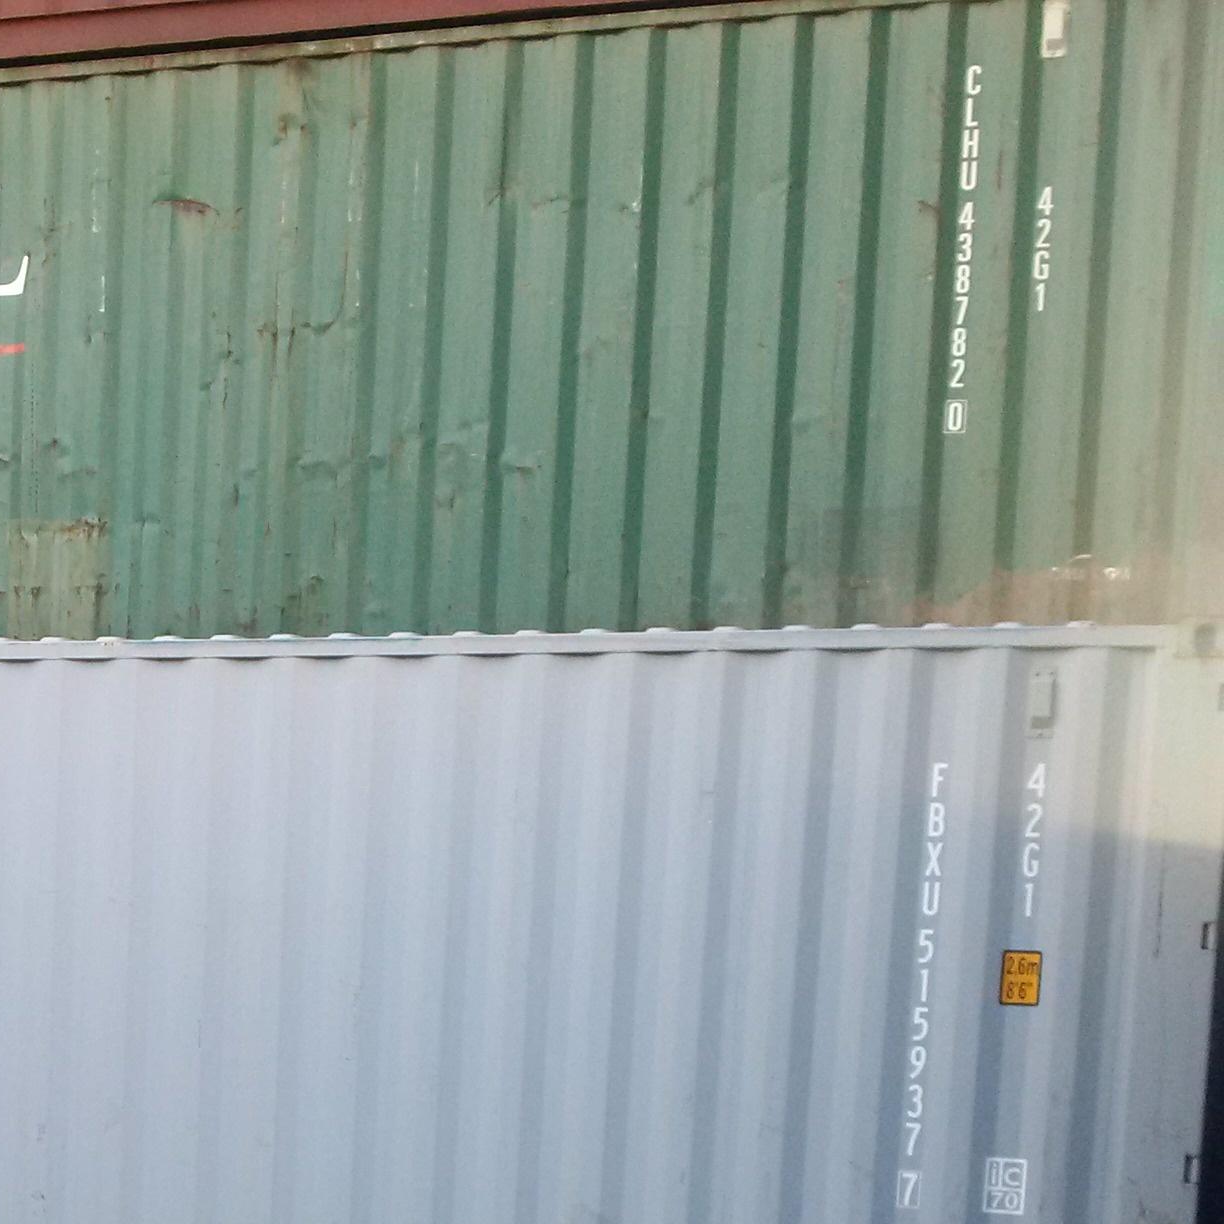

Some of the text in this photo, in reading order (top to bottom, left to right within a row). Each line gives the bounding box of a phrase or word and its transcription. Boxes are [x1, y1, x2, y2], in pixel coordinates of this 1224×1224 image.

[959, 65, 982, 191] CLHU
[949, 200, 975, 388] 438782
[1032, 186, 1055, 312] 42G1
[922, 762, 949, 916] FBXU
[1022, 762, 1047, 917] 42G1
[904, 928, 936, 1157] 515937
[991, 1191, 1019, 1209] 70
